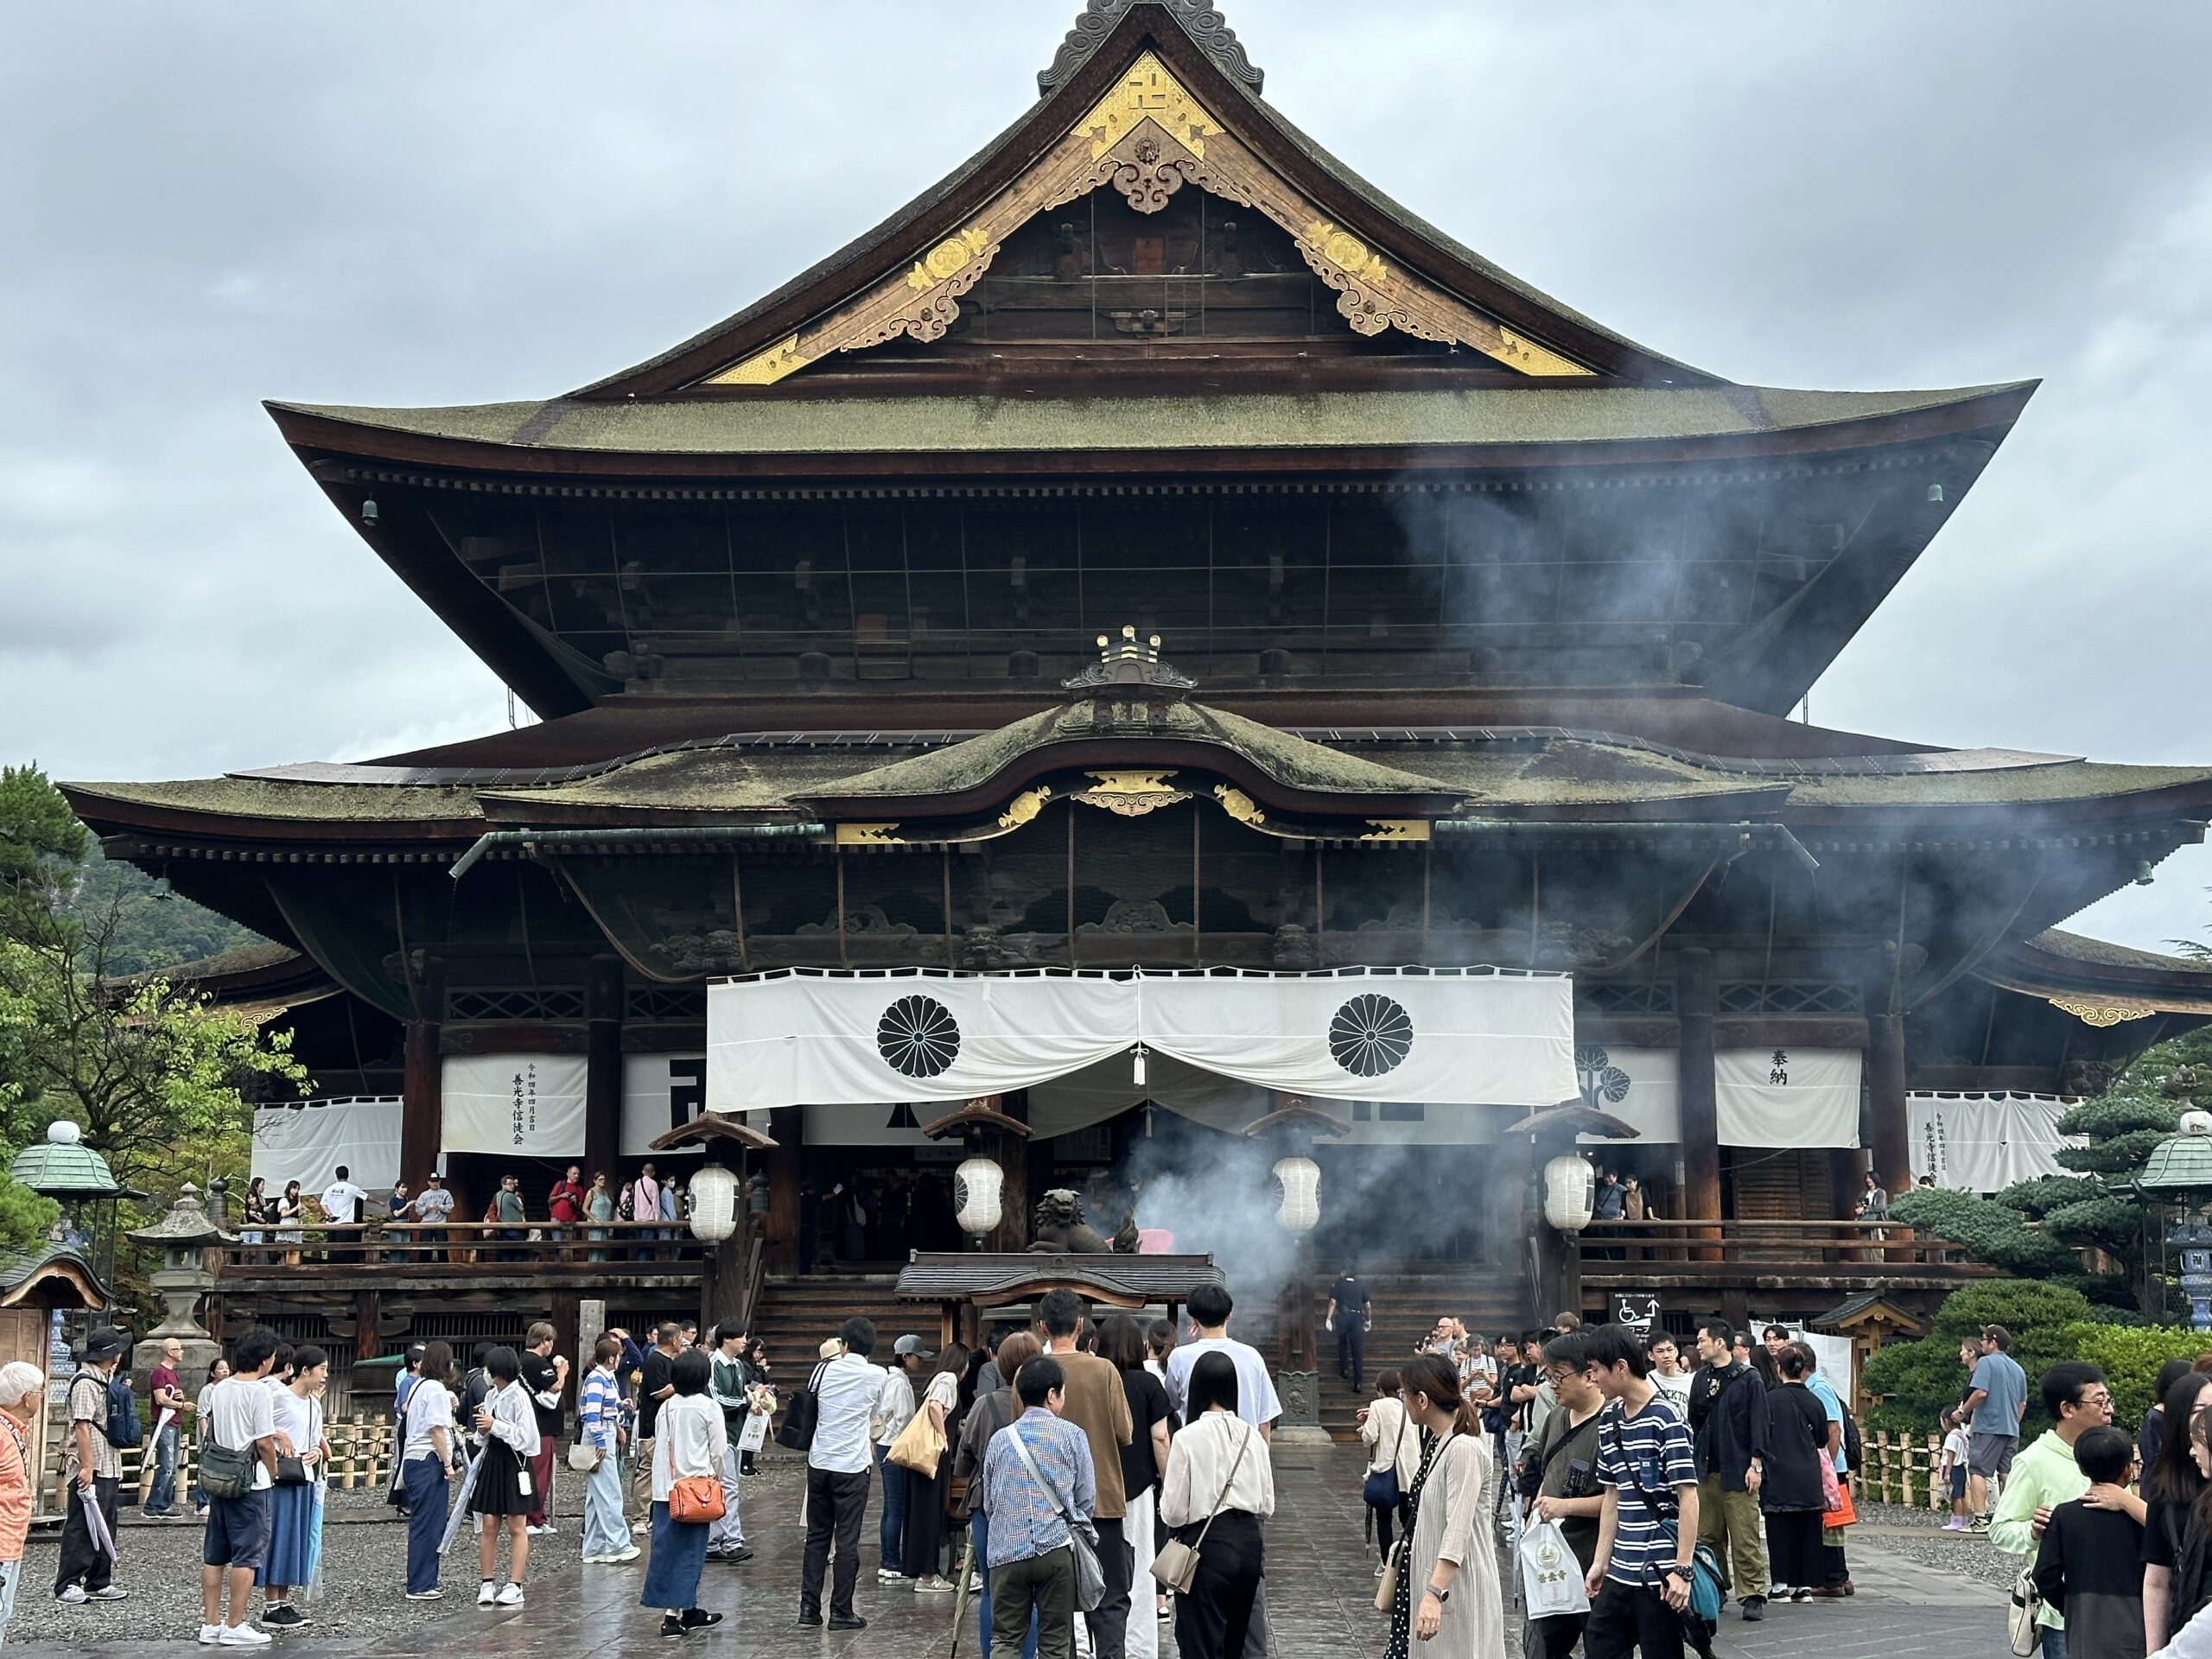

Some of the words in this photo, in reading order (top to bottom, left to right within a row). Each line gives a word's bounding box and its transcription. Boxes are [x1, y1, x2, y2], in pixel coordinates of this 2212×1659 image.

[1770, 1049, 1789, 1086] 奉納
[512, 1072, 524, 1145] 善光寺信徒会
